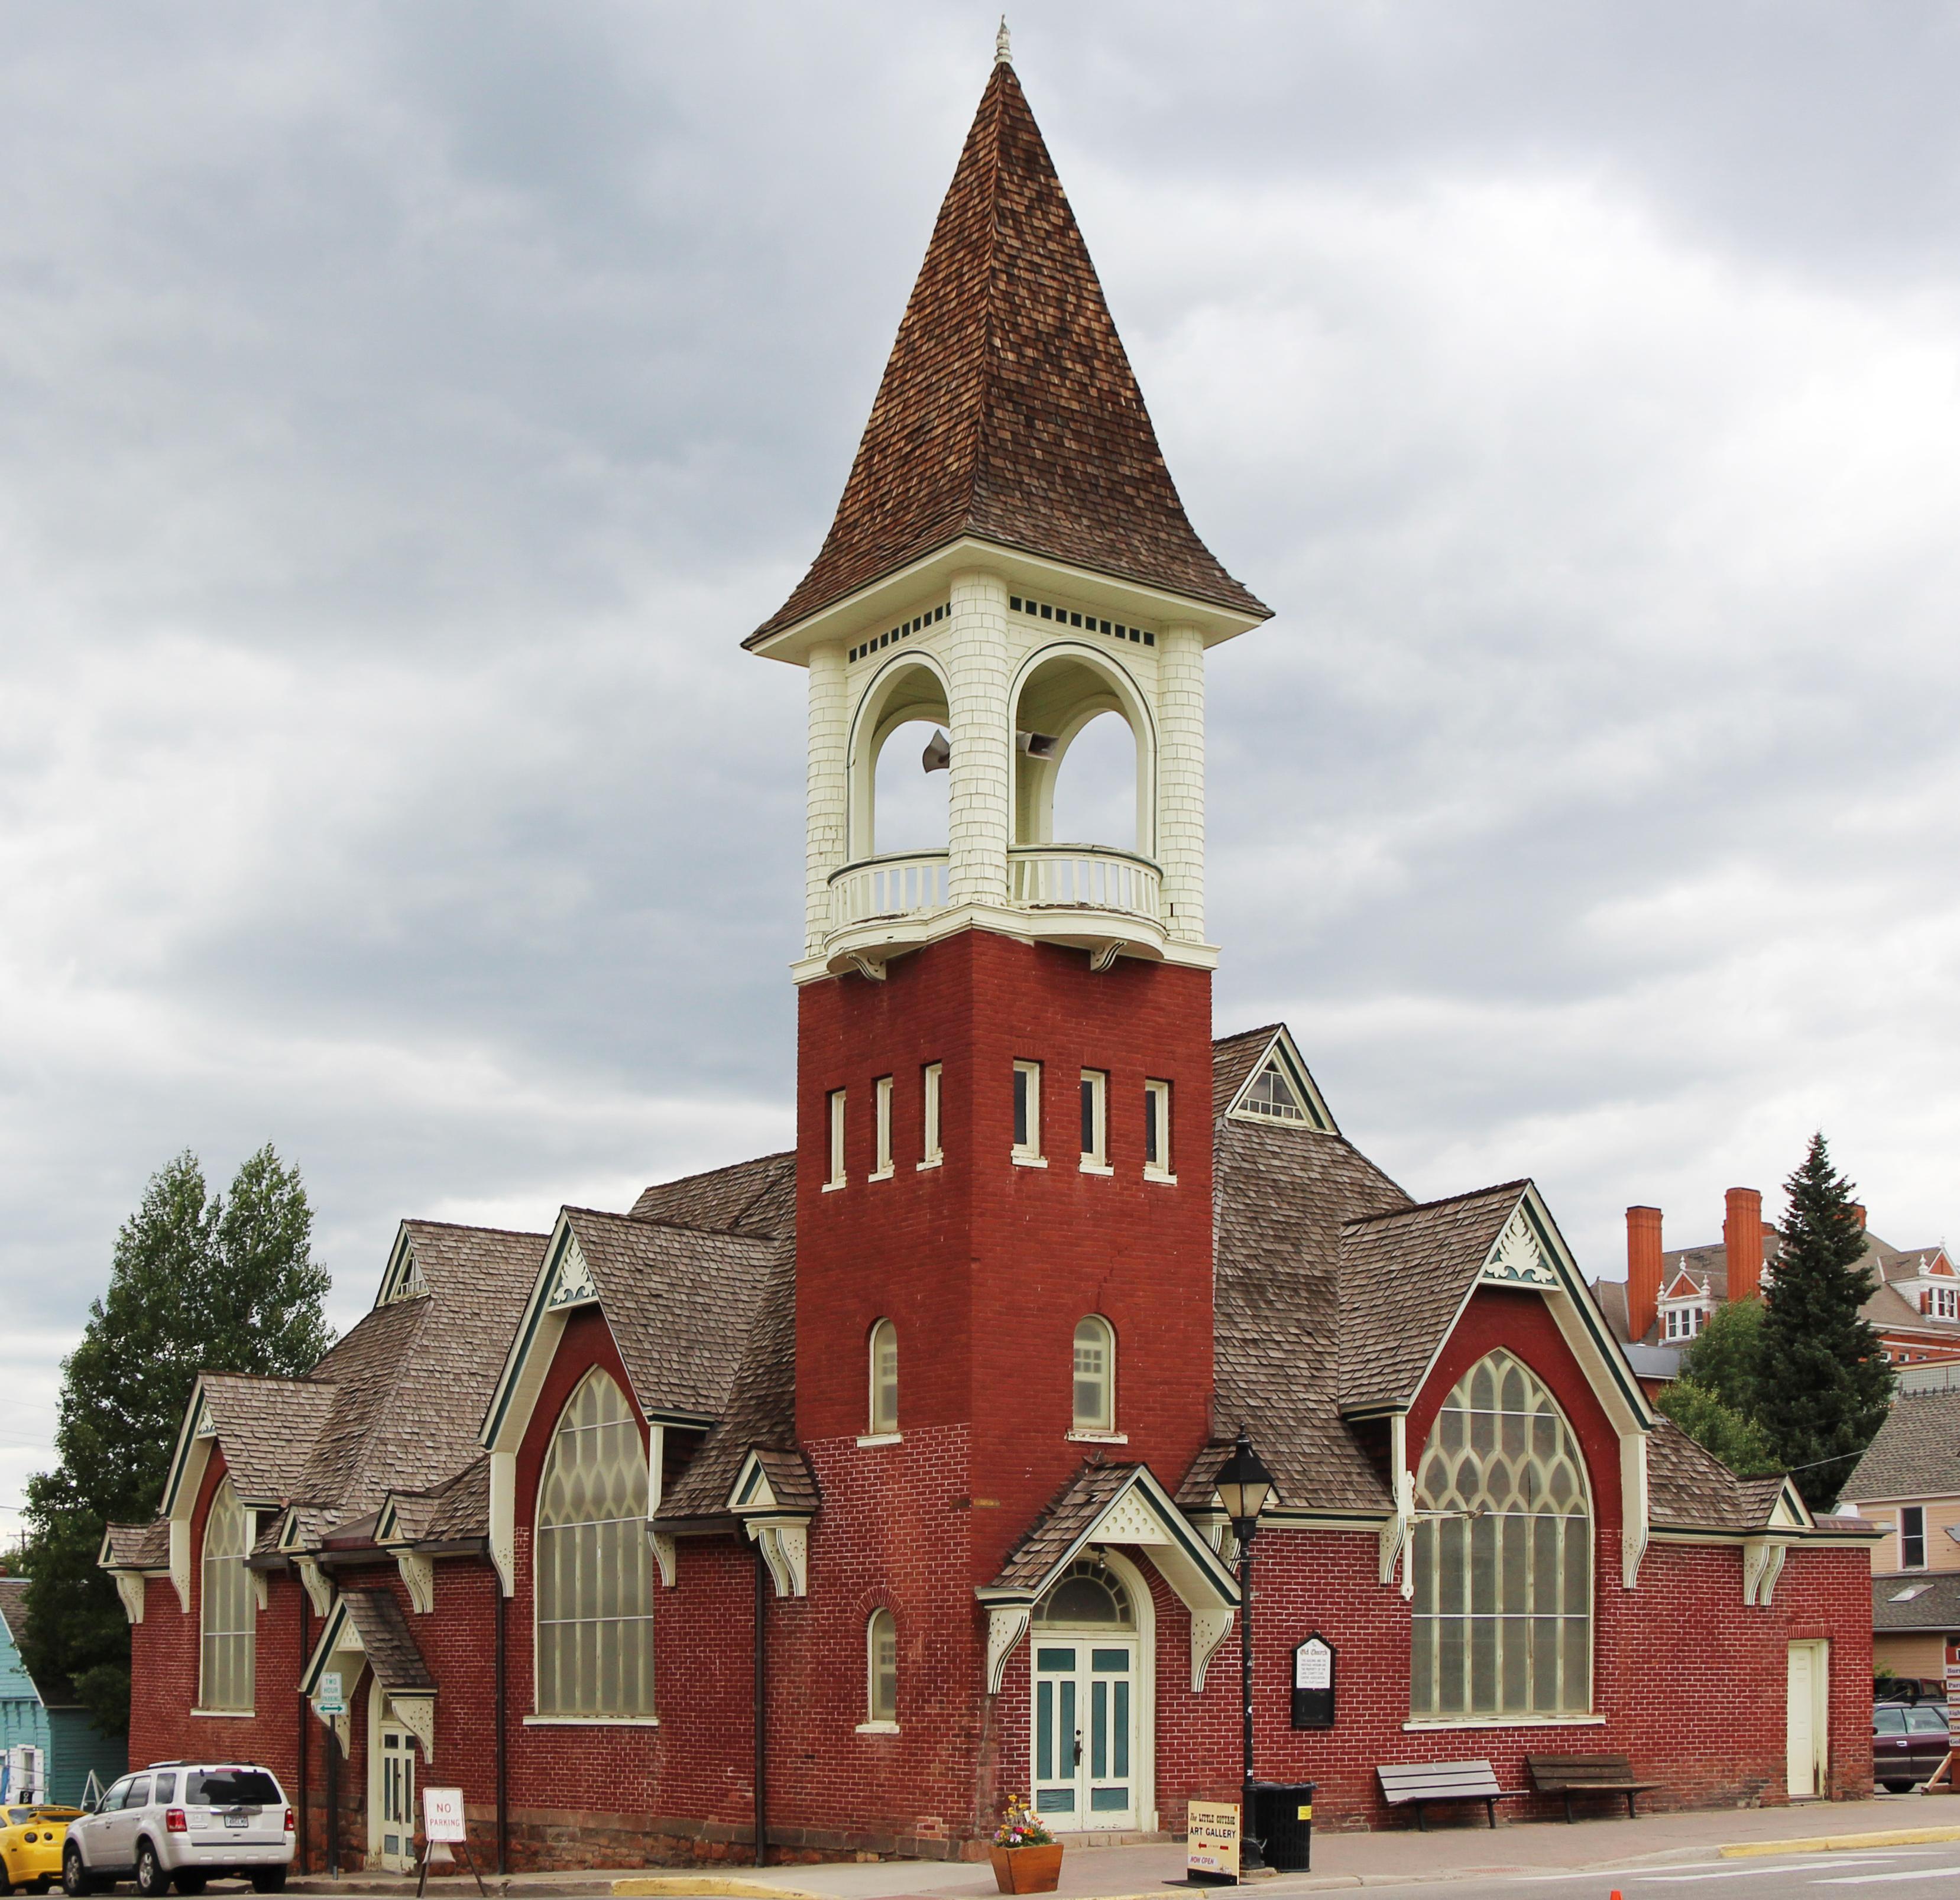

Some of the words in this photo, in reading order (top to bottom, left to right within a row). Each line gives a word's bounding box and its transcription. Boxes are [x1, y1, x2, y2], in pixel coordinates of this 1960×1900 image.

[436, 1803, 451, 1813] NO
[430, 1818, 460, 1827] PARKING
[1199, 1814, 1214, 1823] LITTLE
[1217, 1815, 1235, 1825] COTTAGE
[1190, 1826, 1203, 1836] ART
[1206, 1828, 1236, 1839] GALLERY
